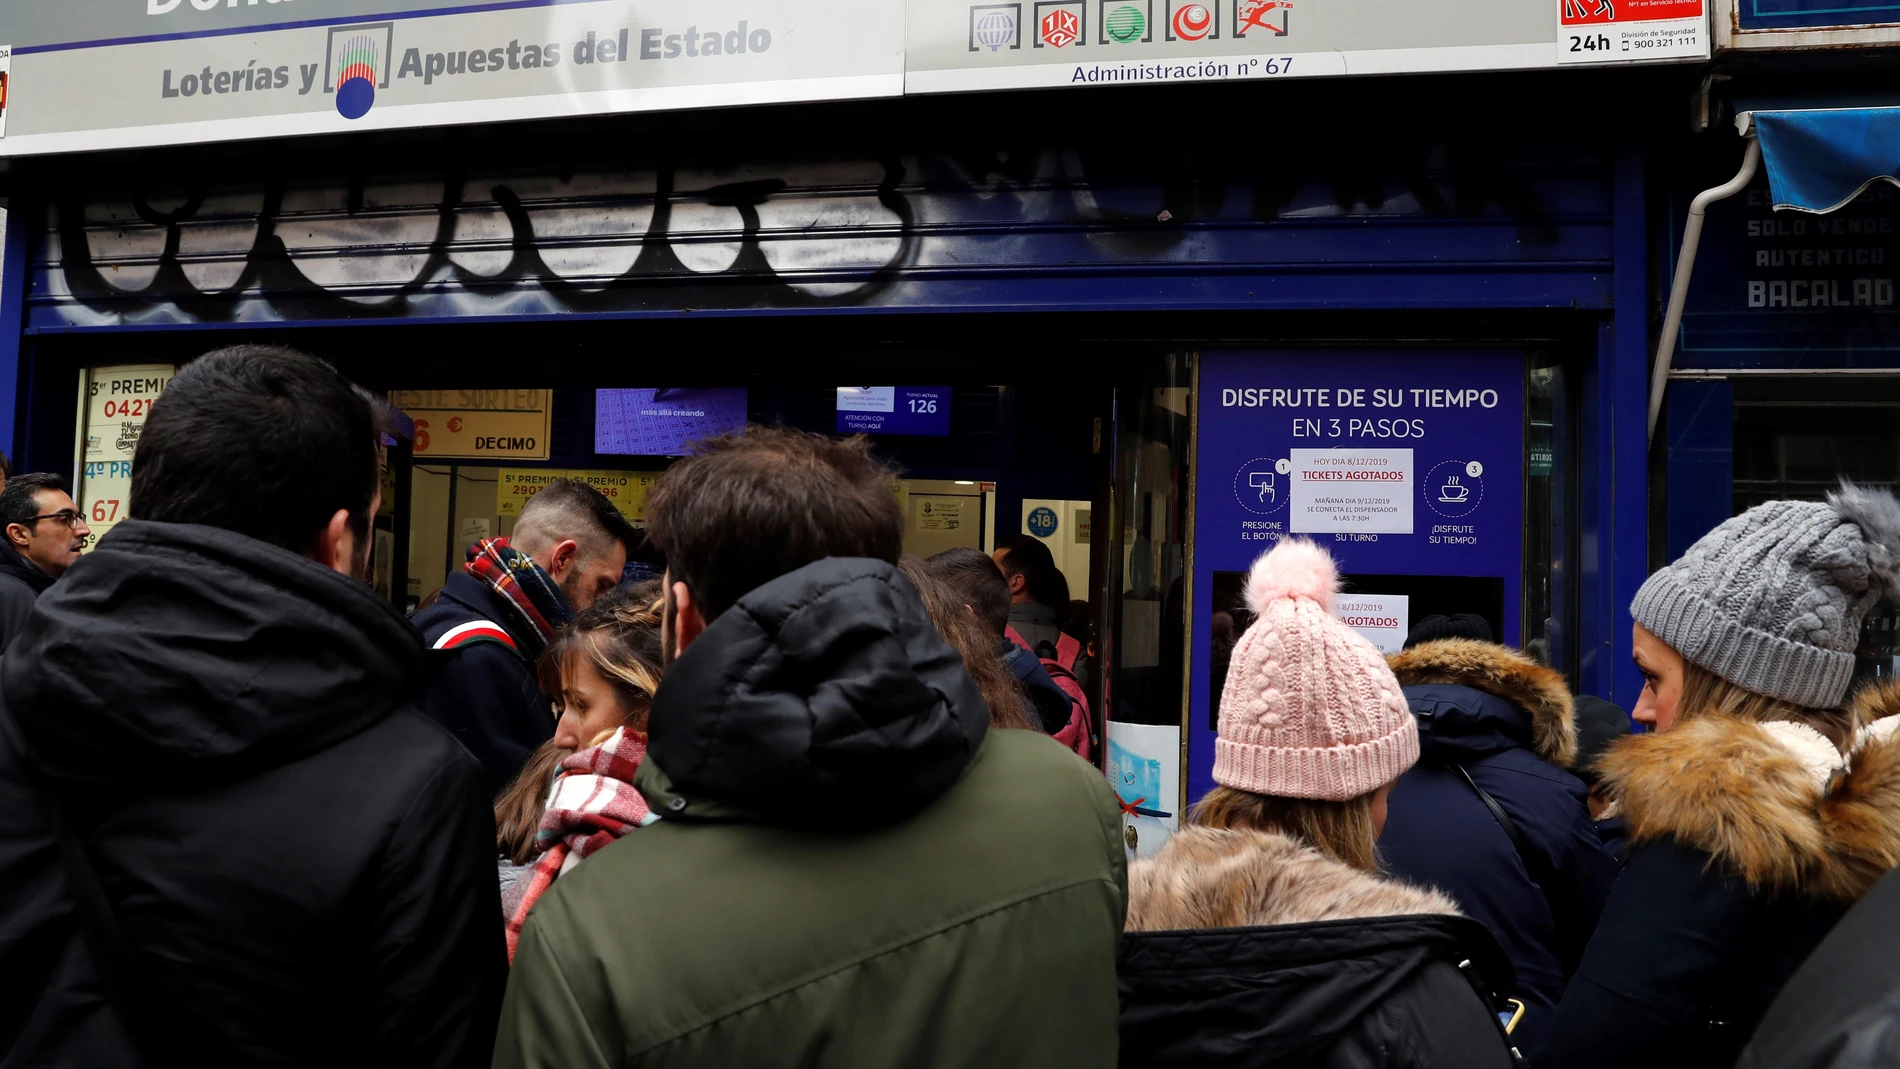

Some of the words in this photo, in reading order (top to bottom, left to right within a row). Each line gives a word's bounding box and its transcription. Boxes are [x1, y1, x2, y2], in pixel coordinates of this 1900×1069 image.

[1621, 31, 1649, 39] División
[1660, 28, 1696, 37] Seguridad
[1569, 34, 1610, 52] 24h
[1634, 40, 1654, 49] 900
[1656, 39, 1673, 47] 321
[1679, 37, 1696, 45] 111
[162, 59, 290, 98] Loterías
[298, 63, 318, 95] y
[397, 38, 562, 85] Apuestas
[573, 29, 629, 66] del
[640, 20, 773, 61] Estado
[1071, 60, 1230, 83] Administración
[1237, 58, 1258, 76] nº
[1265, 57, 1294, 75] 67
[1747, 219, 1806, 237] SOLO
[1817, 217, 1893, 235] VENDE
[1756, 248, 1885, 267] AUTENTICO
[1748, 279, 1893, 308] BACALAO
[1222, 388, 1330, 407] DISFRUTE
[1337, 389, 1366, 407] DE
[1372, 389, 1403, 408] SU
[1410, 389, 1499, 409] TIEMPO
[908, 400, 937, 413] 126
[446, 416, 463, 433] €
[1292, 418, 1321, 437] EN
[1328, 418, 1341, 438] 3
[1349, 418, 1425, 438] PASOS
[475, 436, 536, 450] DECIMO
[1313, 458, 1330, 466] HOY
[1332, 458, 1346, 466] DIA
[1347, 458, 1388, 467] 8/12/2019
[1471, 465, 1477, 474] 3
[518, 475, 558, 484] PREMIO
[587, 477, 628, 486] PREMIO
[1302, 471, 1343, 481] TICKETS
[1345, 471, 1404, 481] AGOTADOS
[1314, 496, 1344, 504] MAÑANA
[1031, 514, 1051, 527] +18
[1242, 522, 1282, 530] PRESIONE
[1431, 525, 1474, 534] ¡DISFRUTE
[1242, 532, 1251, 540] EL
[1335, 534, 1347, 542] SU
[1349, 534, 1378, 542] TURNO
[1429, 536, 1441, 544] SU
[1443, 536, 1477, 545] TIEMPO!
[1342, 604, 1383, 612] 8/12/2019
